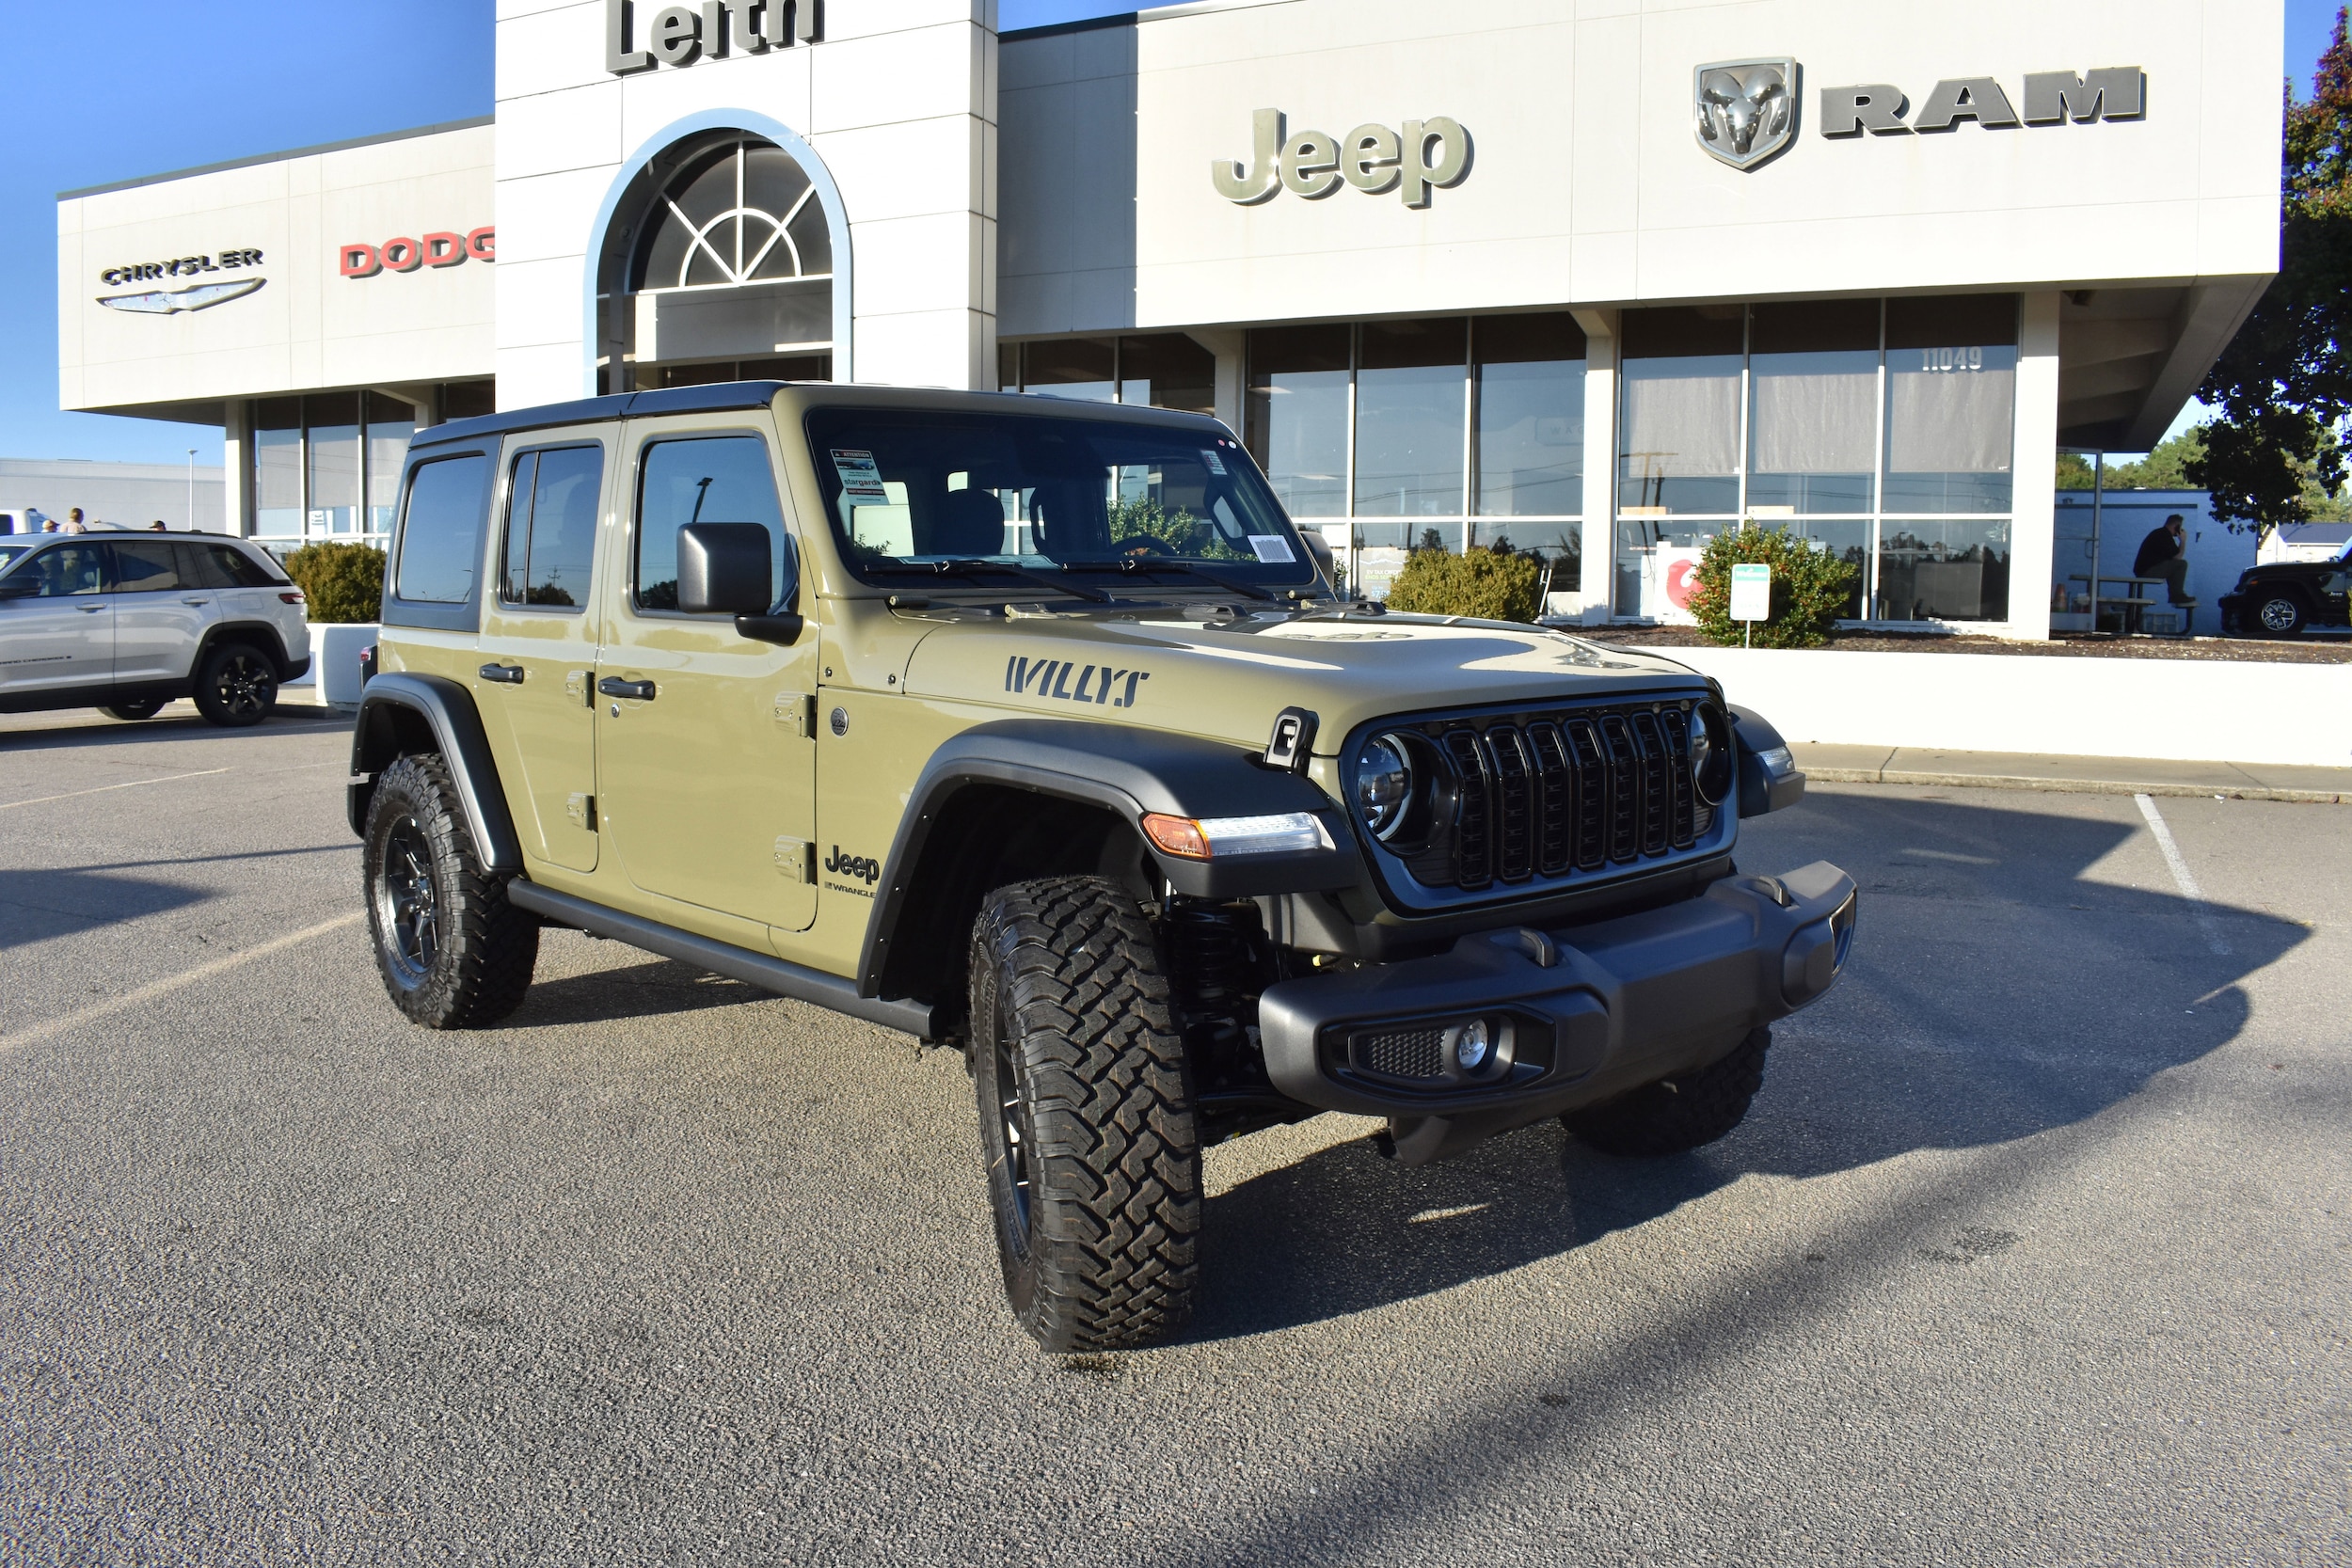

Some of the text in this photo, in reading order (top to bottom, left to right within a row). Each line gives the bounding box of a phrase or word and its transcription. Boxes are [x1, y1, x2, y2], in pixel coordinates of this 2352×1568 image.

[606, 0, 824, 76] Leith
[1820, 66, 2147, 139] RAM
[1211, 107, 1474, 210] Jeep
[100, 247, 264, 285] CHRYSLER
[1922, 346, 1982, 372] 11049
[1005, 656, 1150, 707] WILLYS
[825, 845, 880, 886] Jeep
[833, 882, 877, 899] WRANGLE
